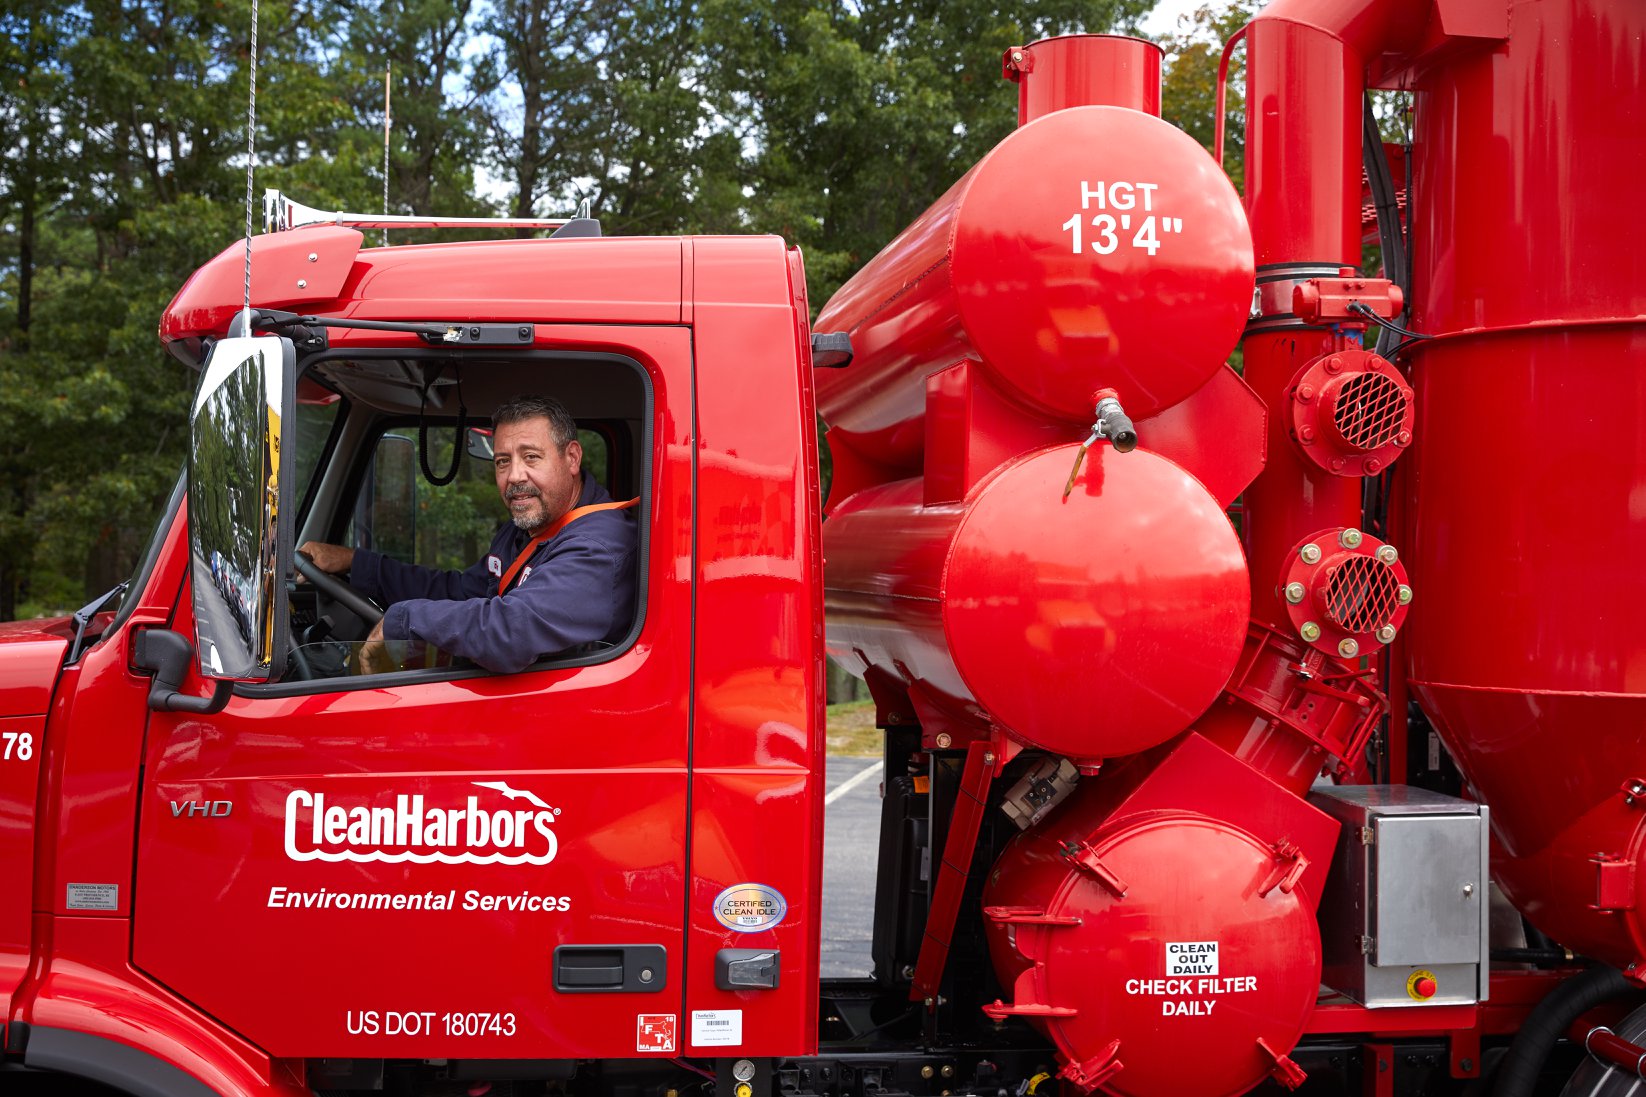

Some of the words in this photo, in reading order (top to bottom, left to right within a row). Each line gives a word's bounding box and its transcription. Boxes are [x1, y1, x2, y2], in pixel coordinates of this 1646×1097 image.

[1079, 181, 1159, 212] HGT
[1062, 214, 1183, 257] 13'4"
[2, 732, 33, 761] 78
[170, 800, 233, 817] VHD
[284, 788, 559, 866] CleanHarbors
[267, 886, 456, 911] Environmental
[462, 889, 572, 912] Services
[723, 908, 753, 916] CLEAN
[756, 908, 776, 916] IDLE
[1169, 944, 1216, 954] CLEAN
[1178, 954, 1208, 964] OUT
[1173, 965, 1213, 974] DAILY
[1125, 979, 1193, 996] CHECK
[1198, 977, 1258, 995] FILTER
[1162, 999, 1217, 1016] DAILY
[346, 1010, 380, 1035] US
[385, 1011, 437, 1036] DOT
[441, 1012, 517, 1037] 180743
